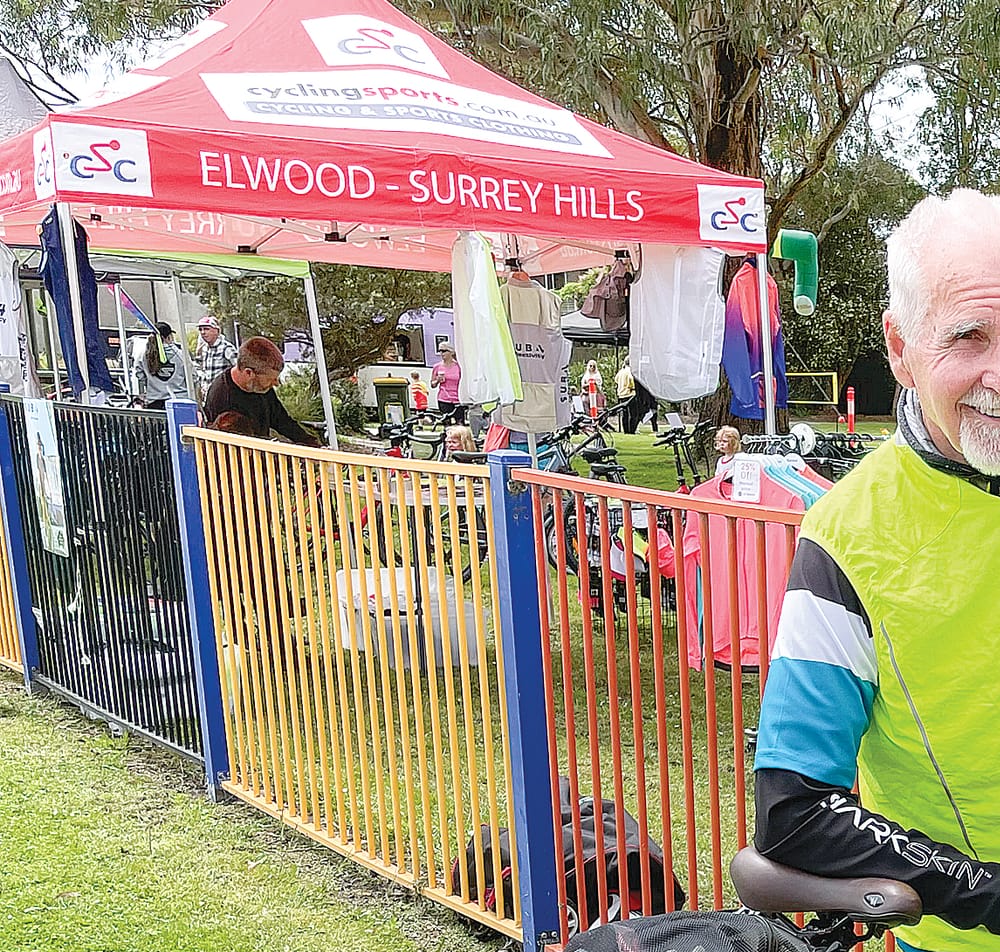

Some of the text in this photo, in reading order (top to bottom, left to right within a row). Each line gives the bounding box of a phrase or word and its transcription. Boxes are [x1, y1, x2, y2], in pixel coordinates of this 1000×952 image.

[246, 83, 556, 127] cyclingsports.com.au
[255, 103, 570, 142] CYCLING & SPORTS CLOTHING
[200, 151, 376, 199] ELWOOD
[408, 170, 544, 213] SURREY
[554, 184, 645, 222] HILLS
